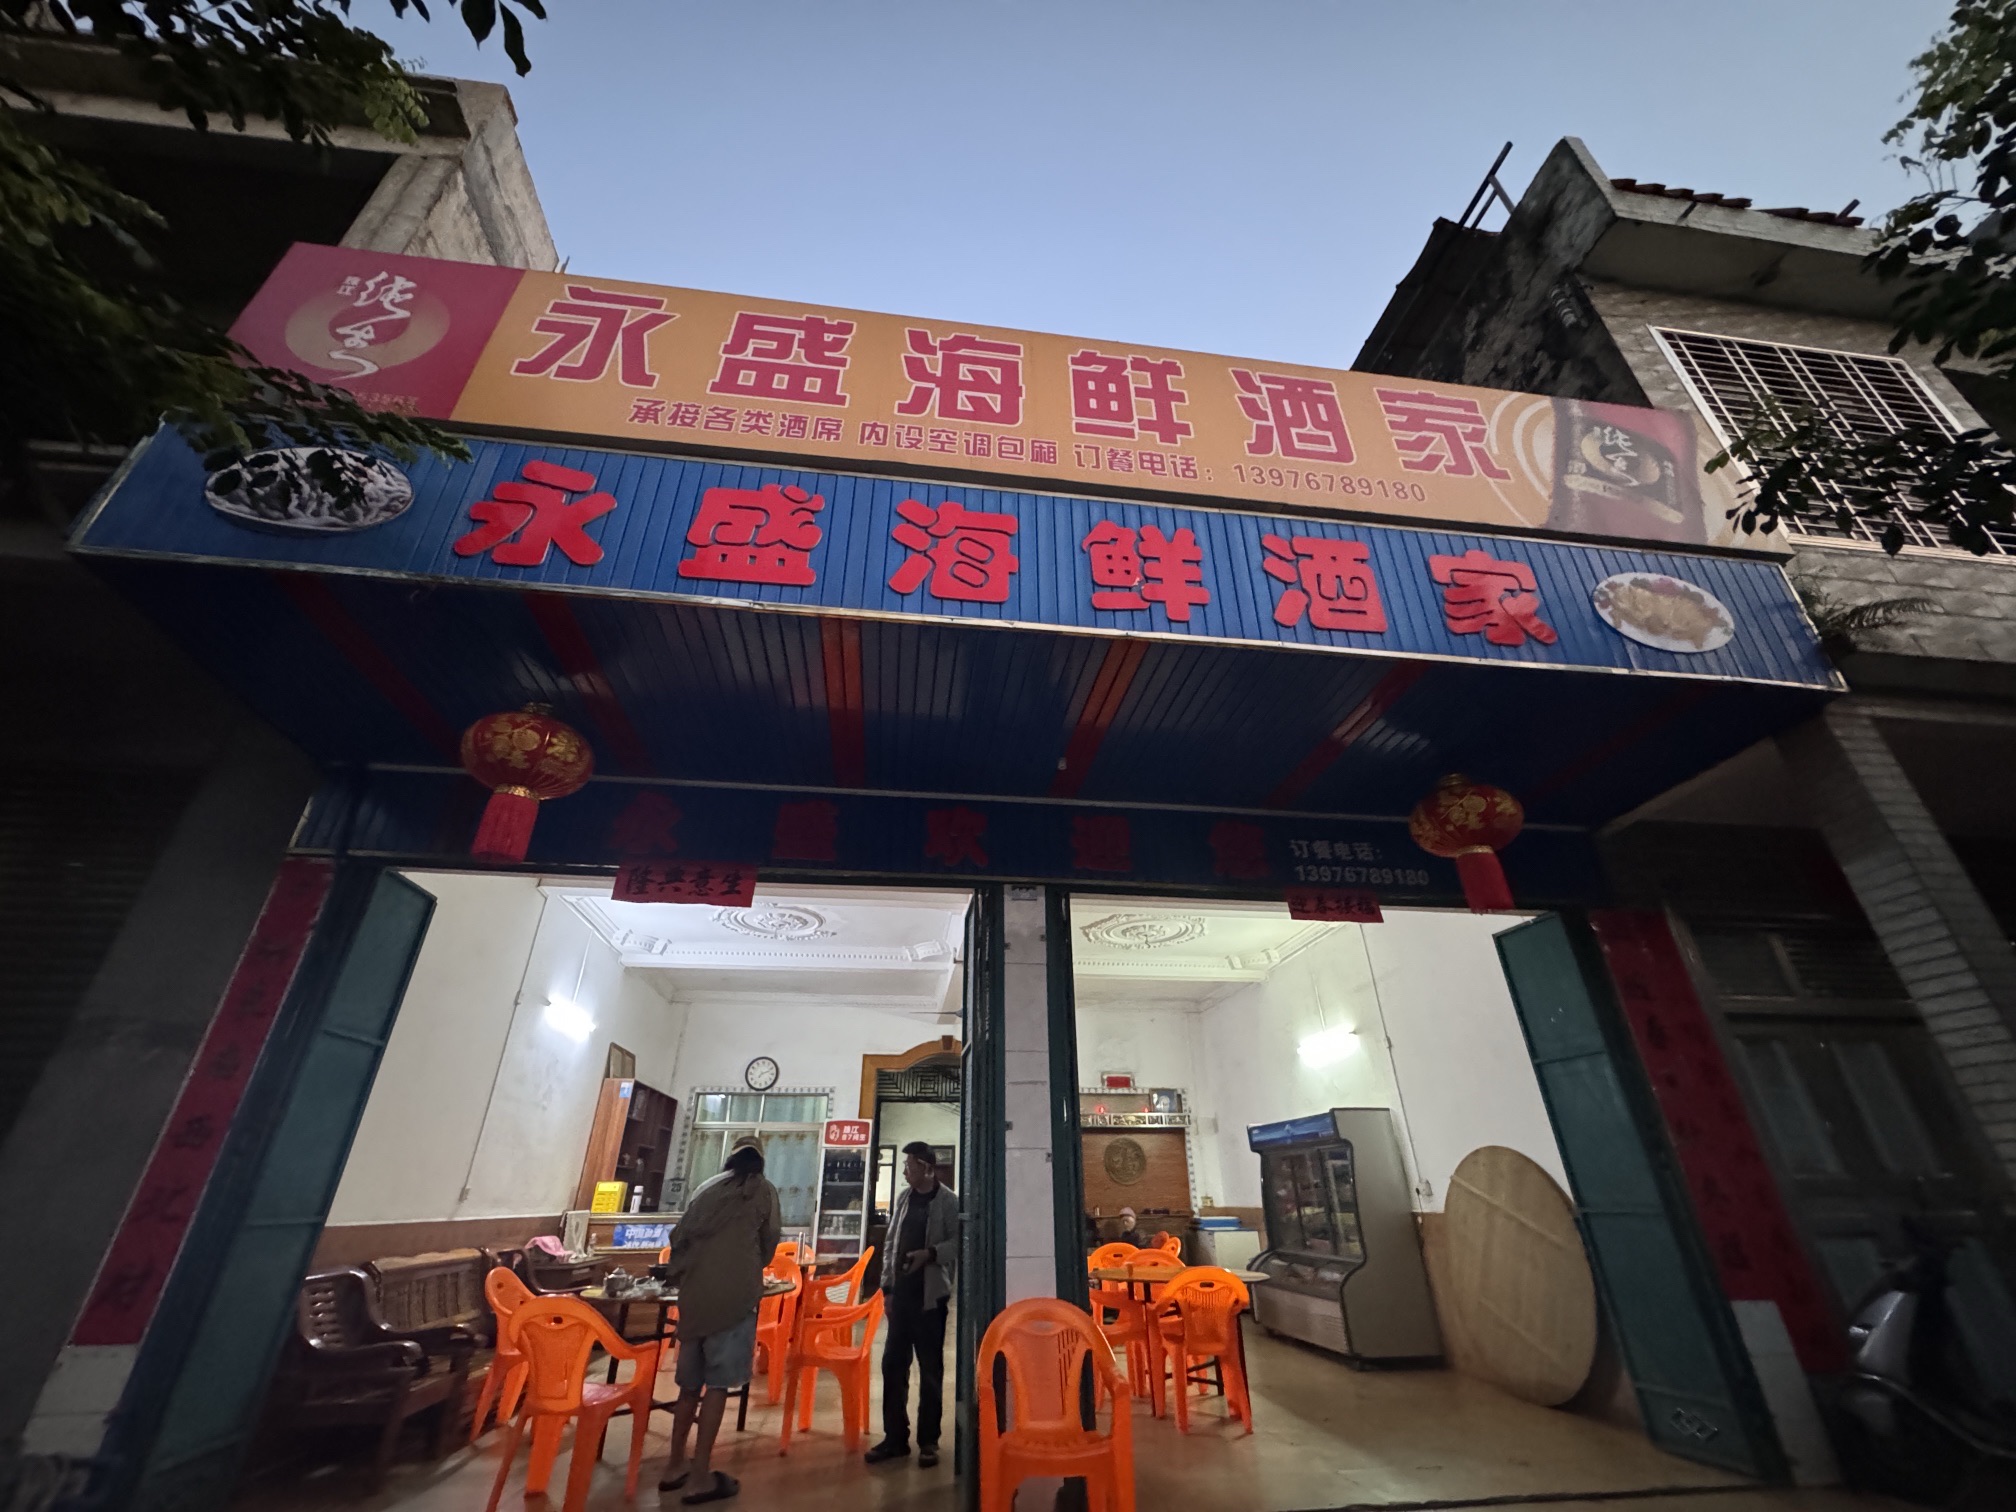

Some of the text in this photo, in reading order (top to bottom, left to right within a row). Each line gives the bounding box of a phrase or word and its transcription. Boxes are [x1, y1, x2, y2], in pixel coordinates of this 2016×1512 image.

[512, 284, 1512, 481] 永盛海鲜酒家
[627, 397, 845, 442] 承接各类酒席
[858, 421, 1058, 466] 内设空调包厢
[1233, 464, 1427, 502] 13976789180
[453, 460, 1558, 646] 永盛海鲜酒家
[1295, 864, 1430, 886] 13976789180
